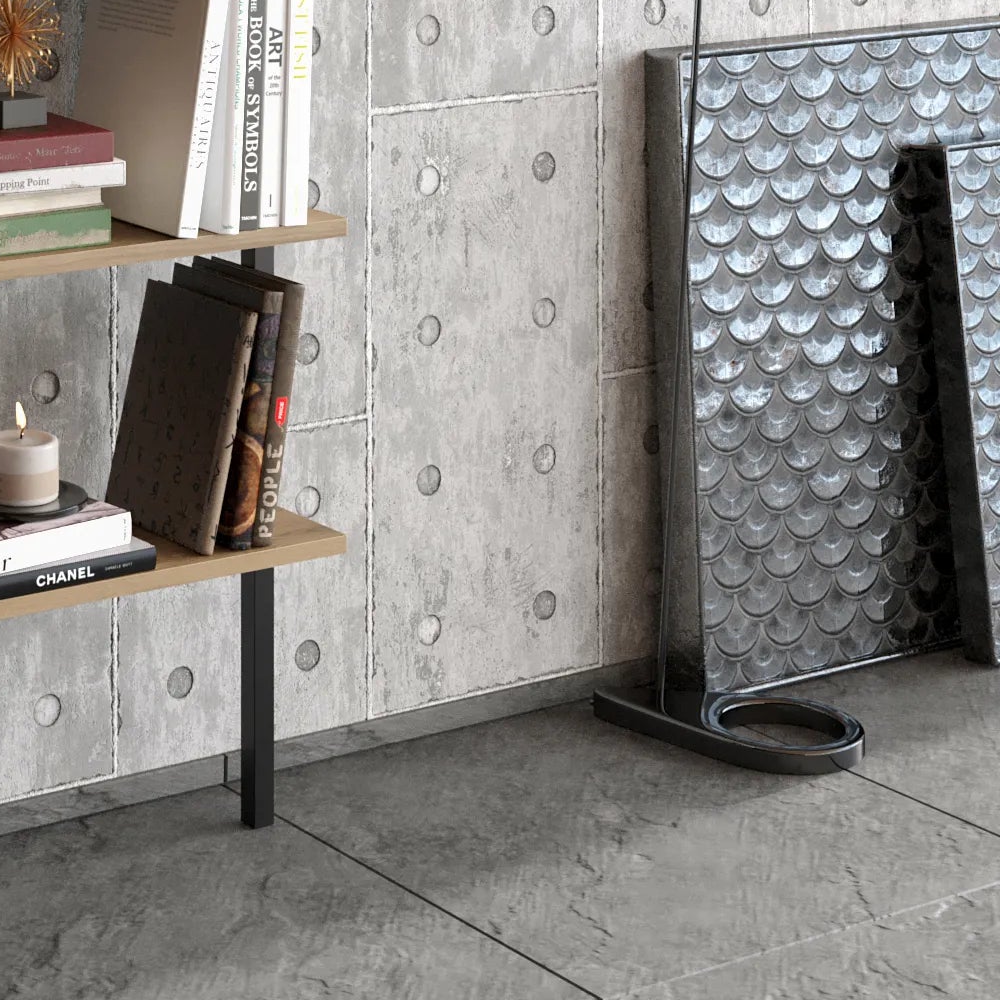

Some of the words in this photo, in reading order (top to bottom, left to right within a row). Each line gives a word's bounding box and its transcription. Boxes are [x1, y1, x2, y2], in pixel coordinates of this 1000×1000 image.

[248, 16, 263, 73] BOOK
[268, 27, 283, 67] ART
[243, 93, 261, 192] SYMBOLS
[27, 177, 50, 188] Point
[258, 443, 284, 538] PEOPLE
[36, 565, 95, 588] CHANEL
